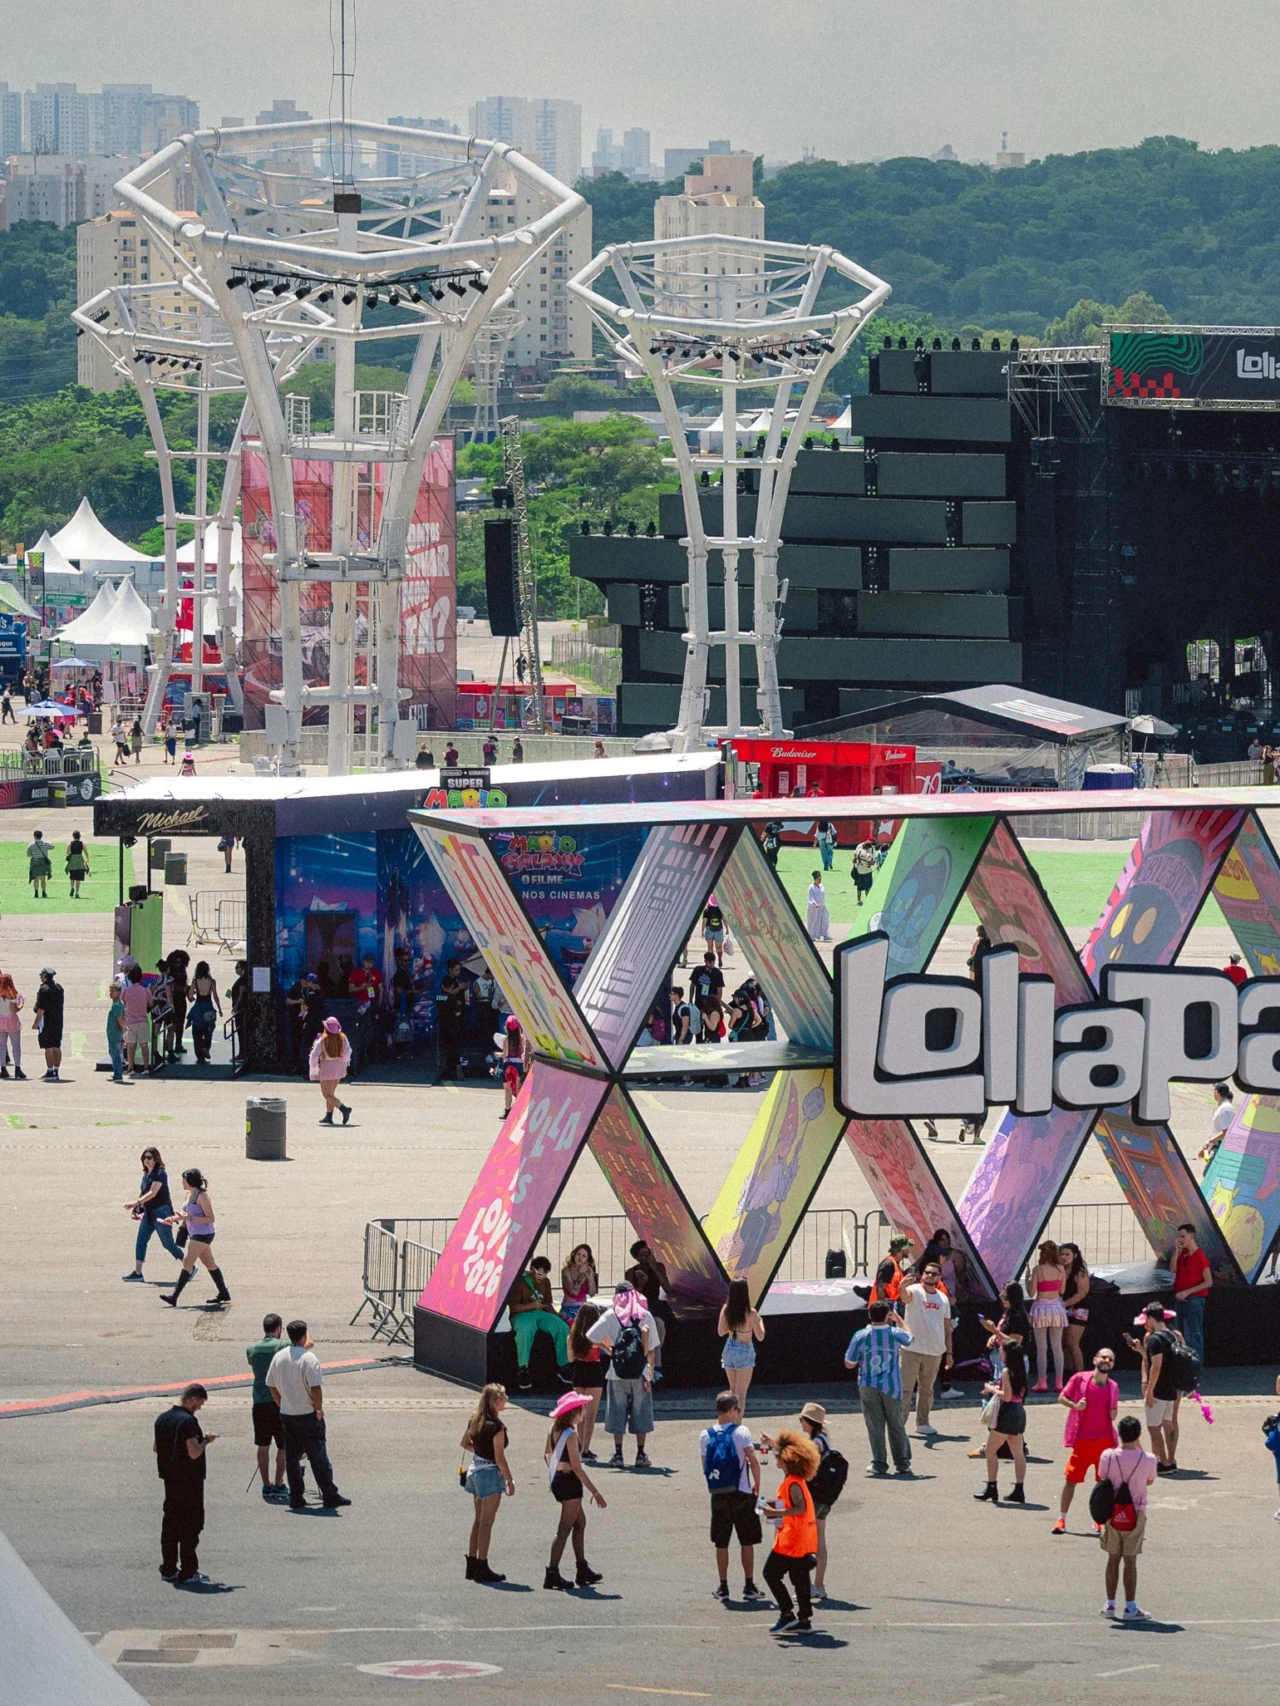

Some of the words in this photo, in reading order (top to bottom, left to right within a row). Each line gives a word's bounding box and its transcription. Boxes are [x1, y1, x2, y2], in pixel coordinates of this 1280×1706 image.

[770, 746, 817, 759] Budweiser
[447, 777, 484, 789] SUPER
[423, 788, 508, 809] MARIO
[136, 805, 209, 835] Michael
[508, 835, 577, 854] MARIO
[501, 852, 586, 877] GALAXY
[521, 875, 531, 885] O
[532, 875, 563, 885] FILME
[522, 890, 546, 900] NOS
[549, 890, 600, 900] CINEMAS
[510, 1096, 581, 1158] LOLLA
[508, 1157, 534, 1205] IS
[462, 1197, 521, 1261] LOVE
[463, 1241, 504, 1298] 2026
